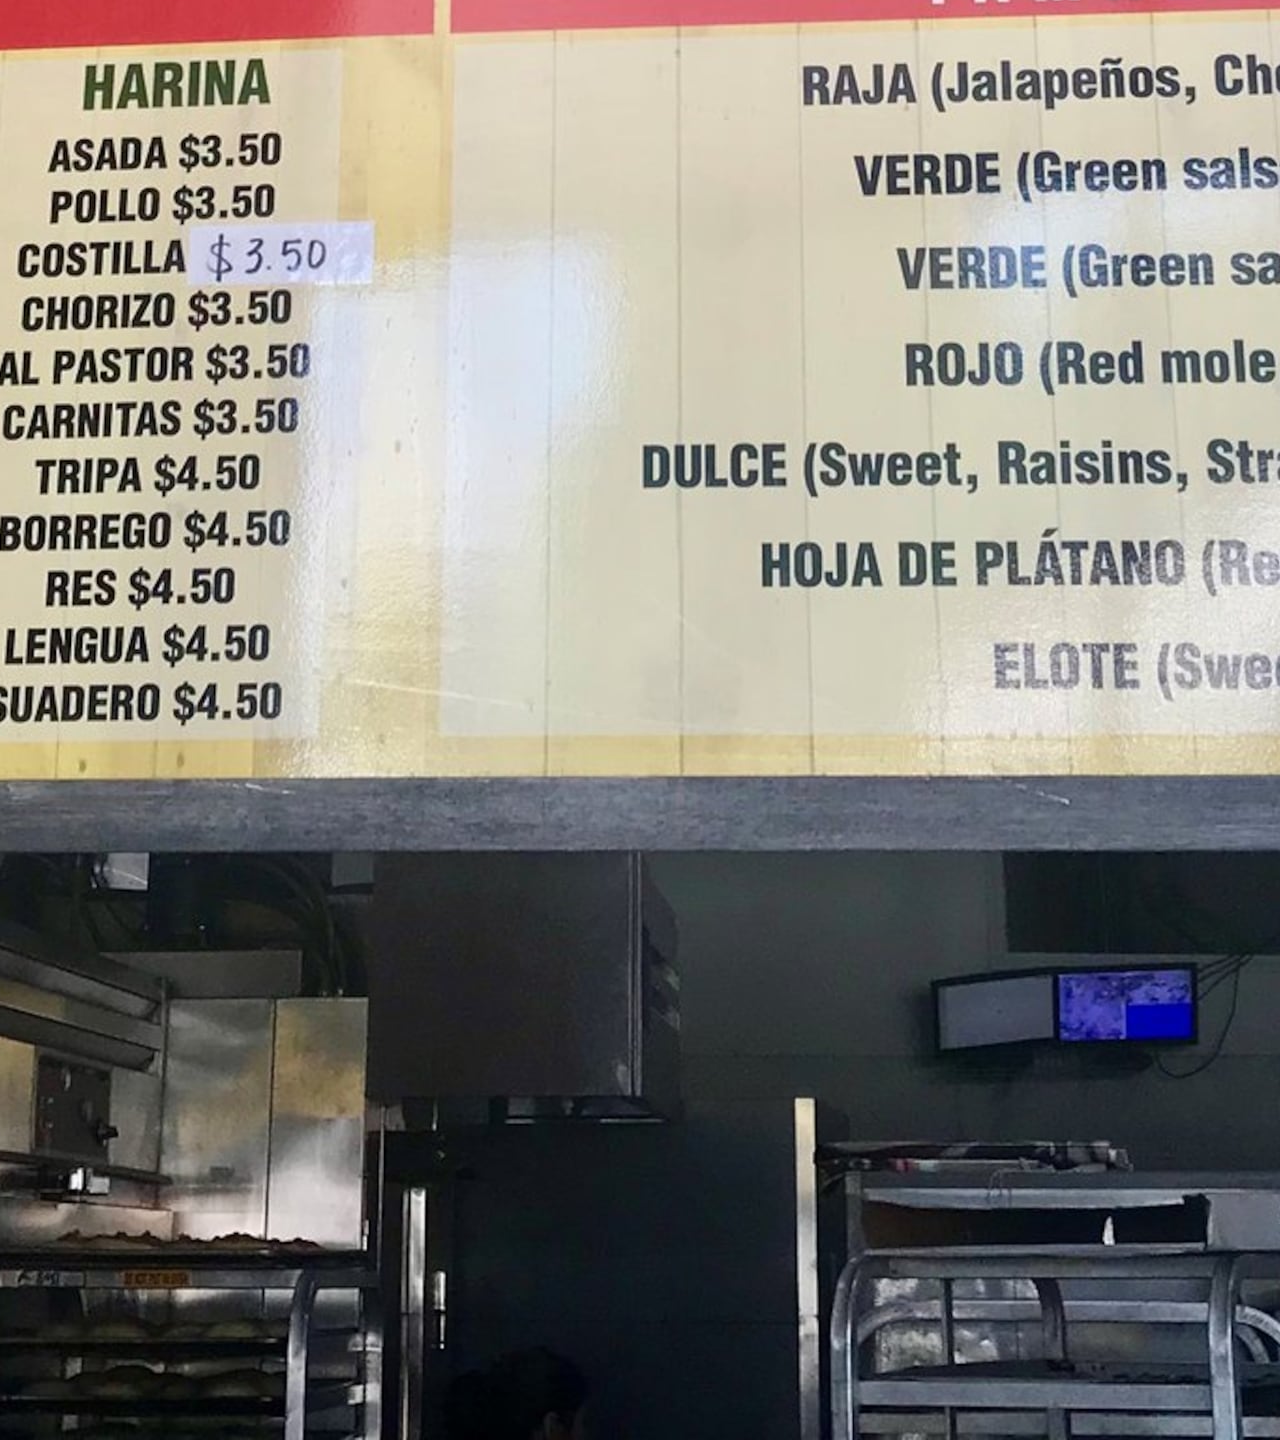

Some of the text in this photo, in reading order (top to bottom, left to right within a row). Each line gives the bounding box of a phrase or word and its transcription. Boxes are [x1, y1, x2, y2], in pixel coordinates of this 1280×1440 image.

[83, 59, 270, 110] HARINA
[803, 63, 917, 105] RAJA
[932, 57, 1196, 112] (Jalapeños,
[48, 132, 281, 173] ASADA $3.50
[854, 152, 1001, 196] VERDE
[1017, 150, 1167, 203] (Green
[50, 184, 275, 225] POLLO $3.50
[18, 239, 186, 278] COSTILLA
[210, 234, 326, 282] $3.50
[896, 246, 1046, 290] VERDE
[1063, 244, 1214, 298] (Green
[21, 289, 292, 332] CHORIZO $3.50
[53, 346, 194, 385] PASTOR
[206, 343, 310, 386] $3.50
[905, 342, 1023, 386] ROJO
[1040, 340, 1144, 396] (Red
[3, 397, 299, 440] CARNITAS $3.50
[35, 454, 260, 498] TRIPA $4.50
[643, 443, 787, 488] DULCE
[804, 442, 977, 498] (Sweet,
[998, 440, 1188, 493] Raisins,
[183, 509, 291, 553] $4.50
[762, 542, 883, 588] HOJA
[898, 541, 957, 586] DE
[975, 528, 1185, 586] PLÁTANO
[46, 566, 235, 611] RES $4.50
[5, 623, 270, 668] LENGUA $4.50
[994, 643, 1139, 689] ELOTE
[173, 681, 282, 726] $4.50
